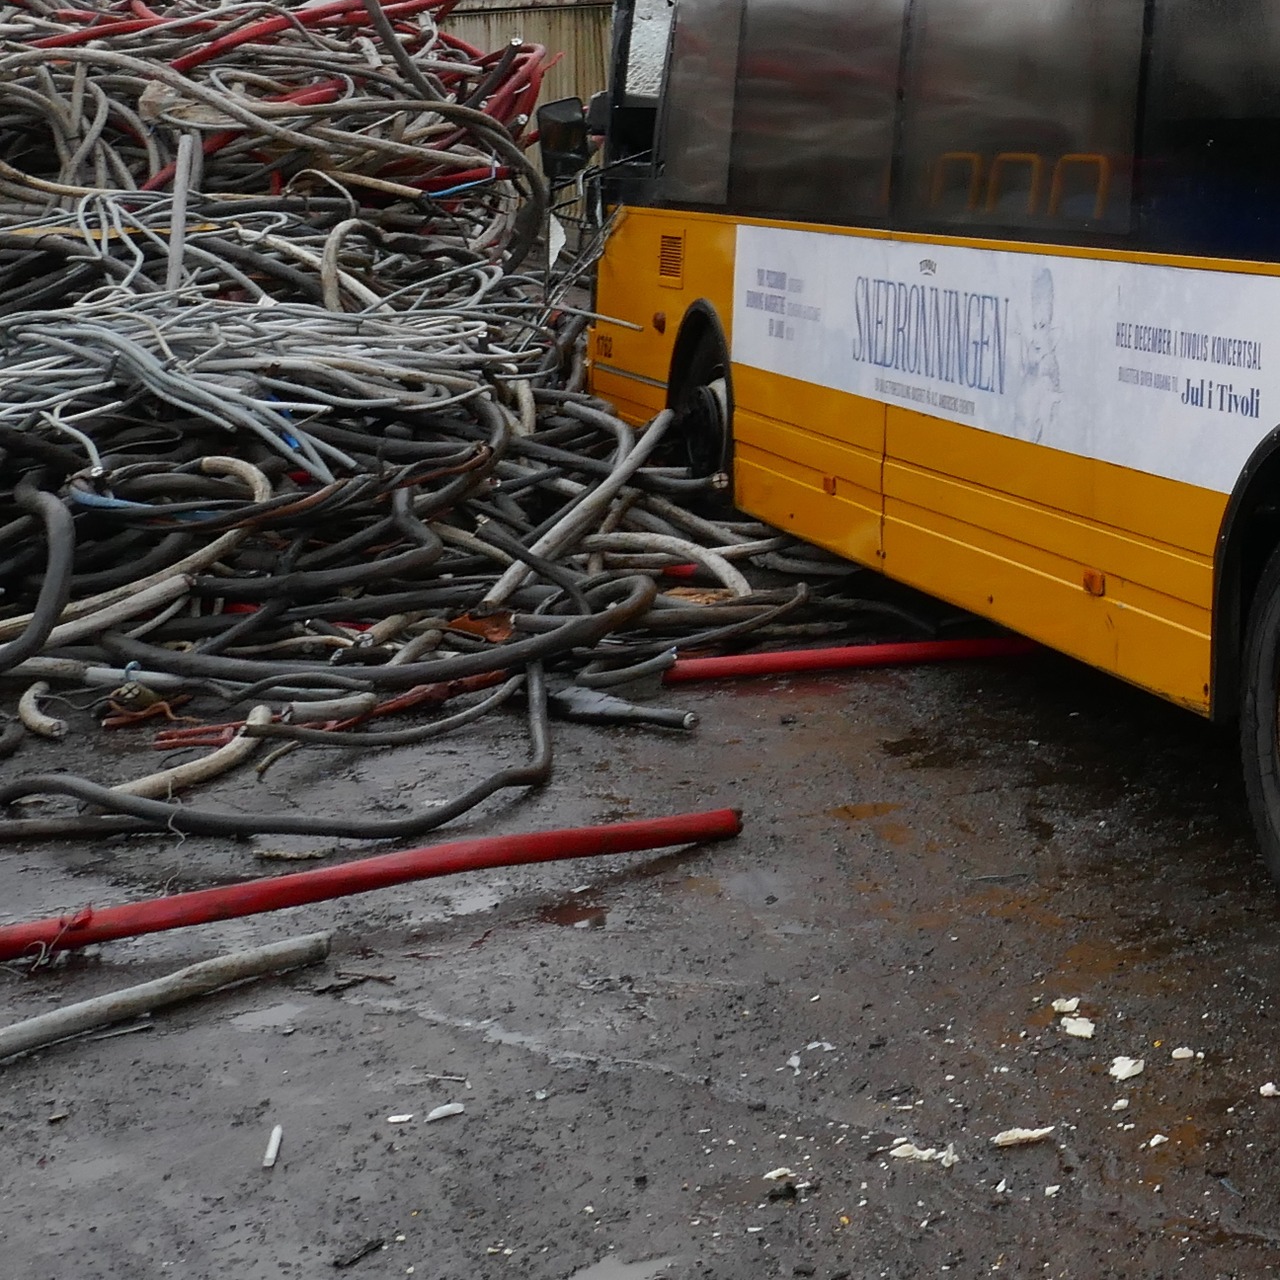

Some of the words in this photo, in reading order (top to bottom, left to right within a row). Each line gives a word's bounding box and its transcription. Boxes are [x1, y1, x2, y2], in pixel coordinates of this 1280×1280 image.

[853, 275, 1009, 395] SNEDRONNINGEN
[1116, 322, 1132, 349] HELE
[1134, 324, 1171, 355] DECEMBER
[1180, 331, 1209, 362] TIVOLIS
[1211, 336, 1262, 370] KONCERTSAL
[1181, 378, 1205, 408] Jul
[1207, 380, 1213, 409] i
[1217, 383, 1261, 418] Tivoli
